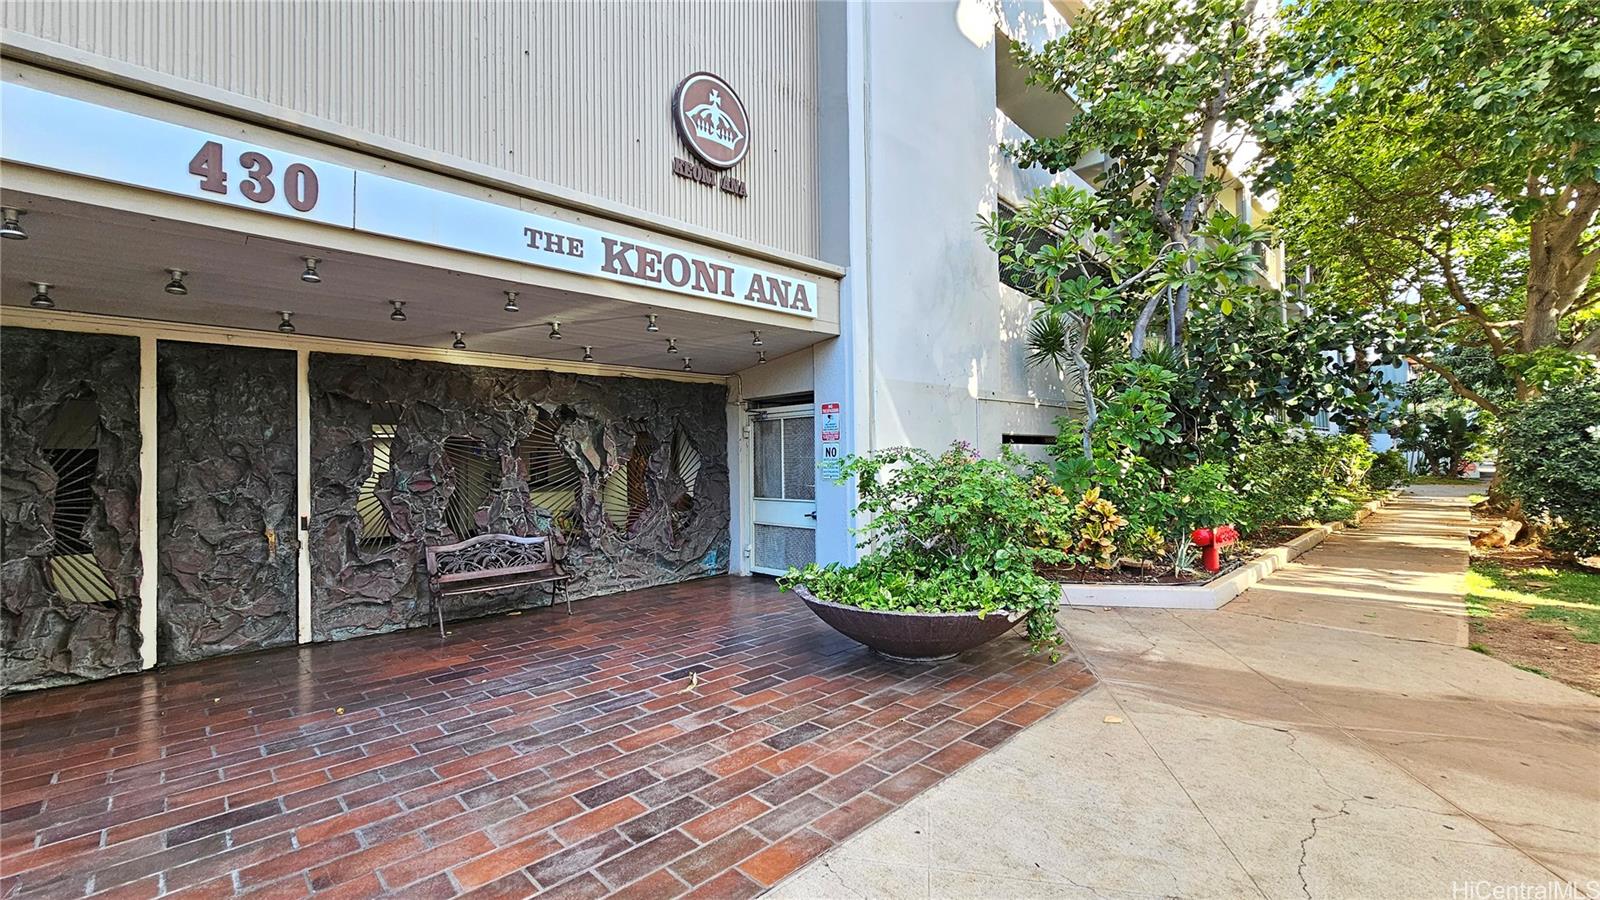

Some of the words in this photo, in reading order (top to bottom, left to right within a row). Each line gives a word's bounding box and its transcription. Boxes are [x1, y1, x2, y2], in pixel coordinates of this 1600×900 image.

[188, 140, 319, 212] 430
[672, 157, 716, 188] KEONI
[720, 176, 748, 198] ANA
[523, 226, 584, 258] THE
[600, 236, 735, 298] KEONI
[744, 273, 812, 312] ANA
[825, 447, 837, 457] NO
